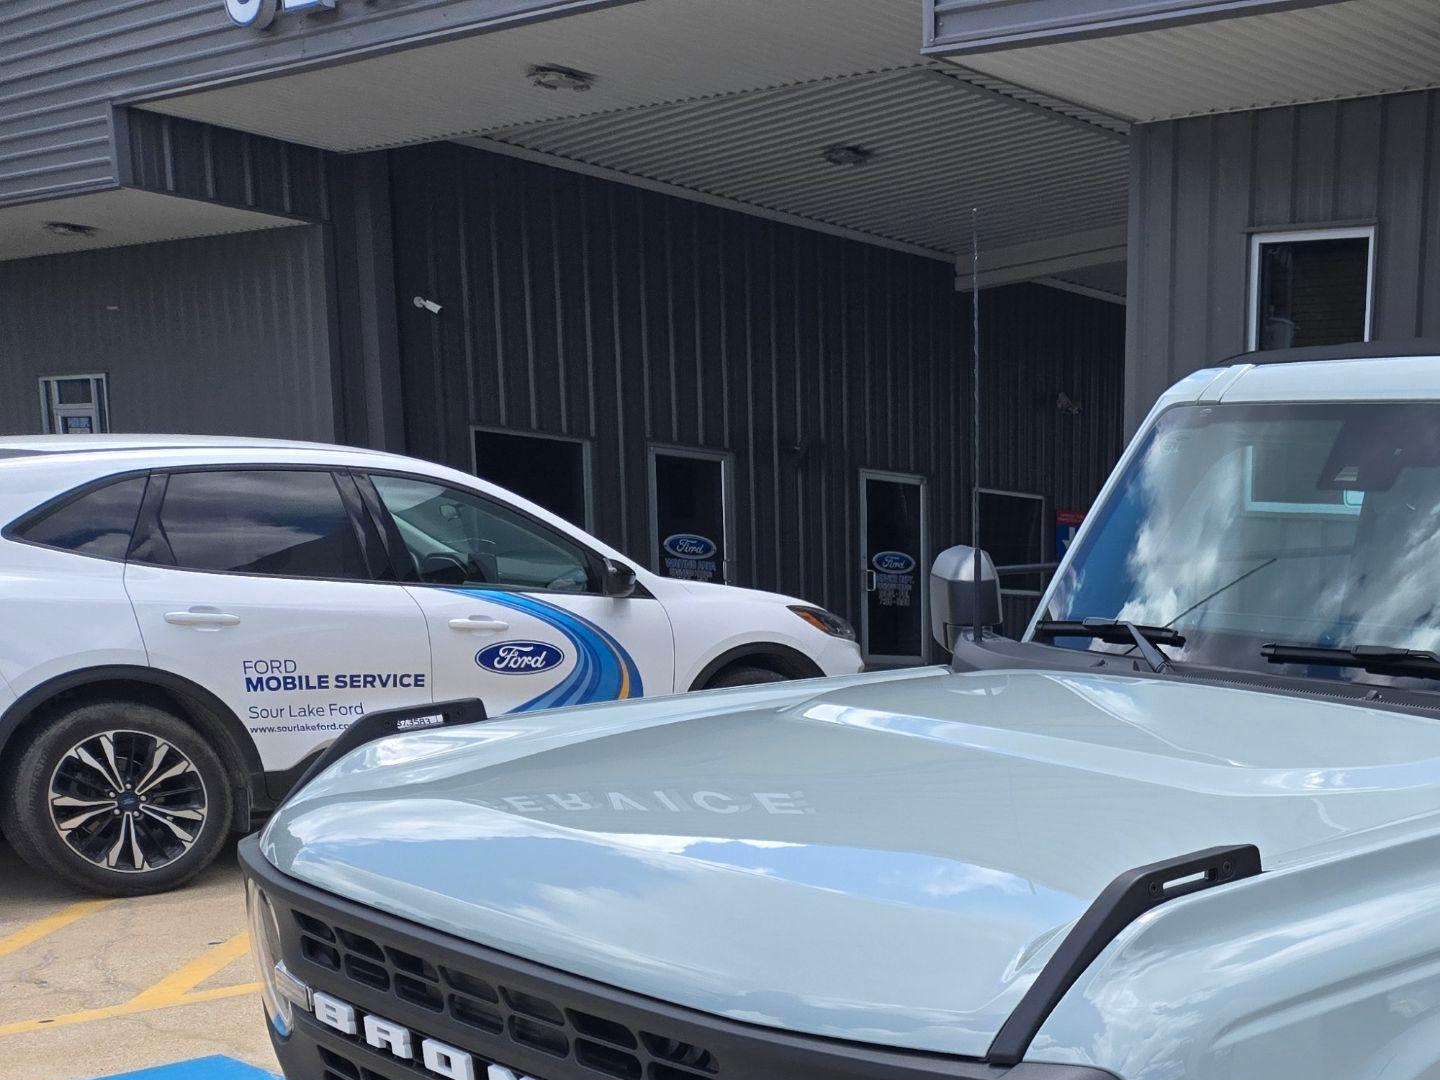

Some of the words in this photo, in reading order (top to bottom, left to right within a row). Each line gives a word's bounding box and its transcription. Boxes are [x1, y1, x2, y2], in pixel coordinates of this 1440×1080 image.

[493, 645, 547, 669] Ford
[243, 659, 297, 675] FORD
[245, 675, 329, 692] MOBILE
[334, 673, 425, 689] SERVICE
[248, 706, 284, 719] Sour
[288, 704, 325, 718] Lake
[329, 702, 364, 716] Ford
[249, 723, 350, 734] www.sourlakeford.co
